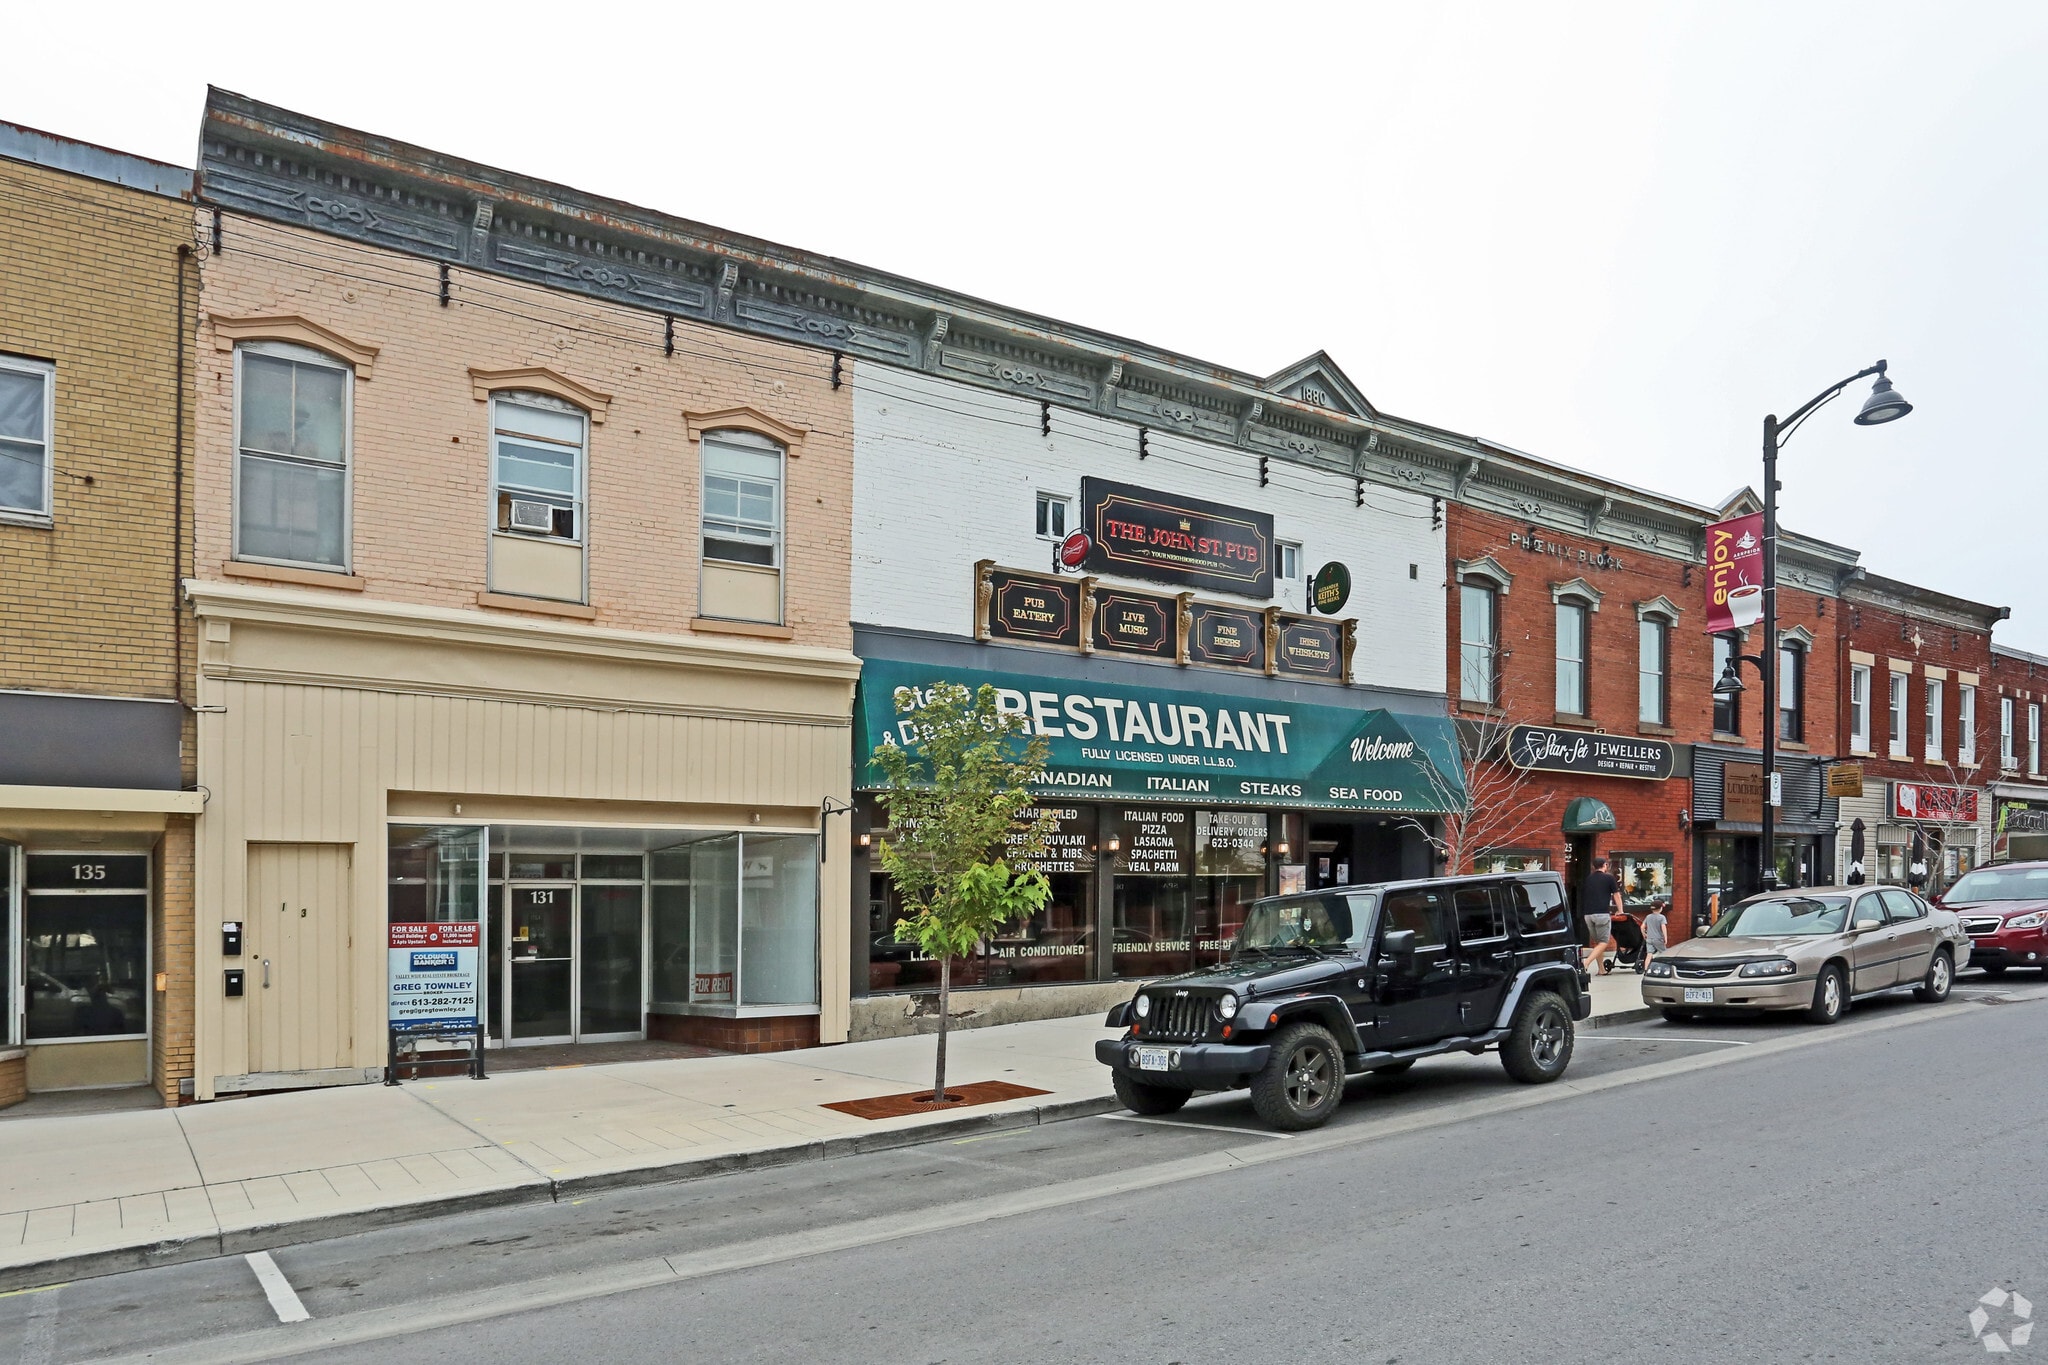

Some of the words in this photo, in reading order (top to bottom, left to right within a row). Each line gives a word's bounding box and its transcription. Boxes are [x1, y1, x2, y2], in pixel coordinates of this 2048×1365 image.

[1303, 386, 1327, 405] 1880
[1106, 519, 1146, 543] THE
[1148, 527, 1196, 551] JOHN
[1197, 537, 1223, 557] ST.
[1225, 542, 1258, 563] PUB
[1151, 550, 1167, 560] YOUR
[1206, 559, 1218, 568] PUB
[1579, 549, 1623, 572] BLOCK
[1709, 529, 1735, 606] enjoy
[1317, 588, 1340, 601] KEITH'S
[1024, 596, 1045, 609] PUB
[1012, 608, 1055, 623] EATERY
[1122, 611, 1146, 623] LIVE
[1118, 623, 1149, 636] MUSIC
[1216, 625, 1238, 636] FINE
[1213, 636, 1241, 648] BEERS
[1299, 636, 1321, 648] IRISH
[1287, 646, 1330, 660] WHISKEYS
[994, 687, 1291, 754] RESTAURANT
[1349, 736, 1414, 764] Welcome
[1594, 742, 1662, 760] JEWELLERS
[1082, 748, 1111, 761] FULLY
[1115, 750, 1164, 764] LICENSED
[1168, 753, 1200, 766] UNDER
[1203, 755, 1237, 768] L.L.B.O.
[1597, 760, 1614, 768] DESIGN
[1619, 762, 1634, 770] REPAIR
[1639, 763, 1656, 772] RESTYLE
[1147, 776, 1210, 792] ITALIAN
[1240, 781, 1302, 798] STEAKS
[1329, 787, 1359, 800] SEA
[1363, 788, 1403, 802] FOOD
[1013, 807, 1078, 820] CHAROILED
[1124, 811, 1158, 822] ITALIAN
[1161, 811, 1184, 823] FOOD
[1251, 815, 1258, 826] &
[1141, 824, 1167, 835] PIZZA
[1196, 825, 1234, 837] DELIVERY
[1237, 827, 1268, 838] ORDERS
[1004, 834, 1035, 845] GREE
[1134, 836, 1174, 848] LASAGNA
[1211, 838, 1254, 849] 623-0344
[1050, 848, 1058, 859] &
[1062, 848, 1083, 859] RIBS
[1130, 849, 1177, 860] SPAGHETTI
[71, 863, 106, 881] 135
[1128, 861, 1151, 872] VEAL
[1154, 862, 1179, 872] PARM
[530, 890, 554, 905] 131
[999, 946, 1015, 958] AIR
[1020, 944, 1085, 957] CONDITIONED
[1112, 942, 1152, 953] FRIENDLY
[1155, 941, 1190, 952] SERVICE
[1199, 940, 1219, 950] FREE
[393, 983, 421, 991] GREG
[424, 982, 472, 990] TOWNLEY
[695, 977, 710, 993] FOR
[711, 976, 732, 993] RENT
[411, 997, 474, 1006] 613-282-7125
[398, 1006, 466, 1015] greg@gregtownley.ca
